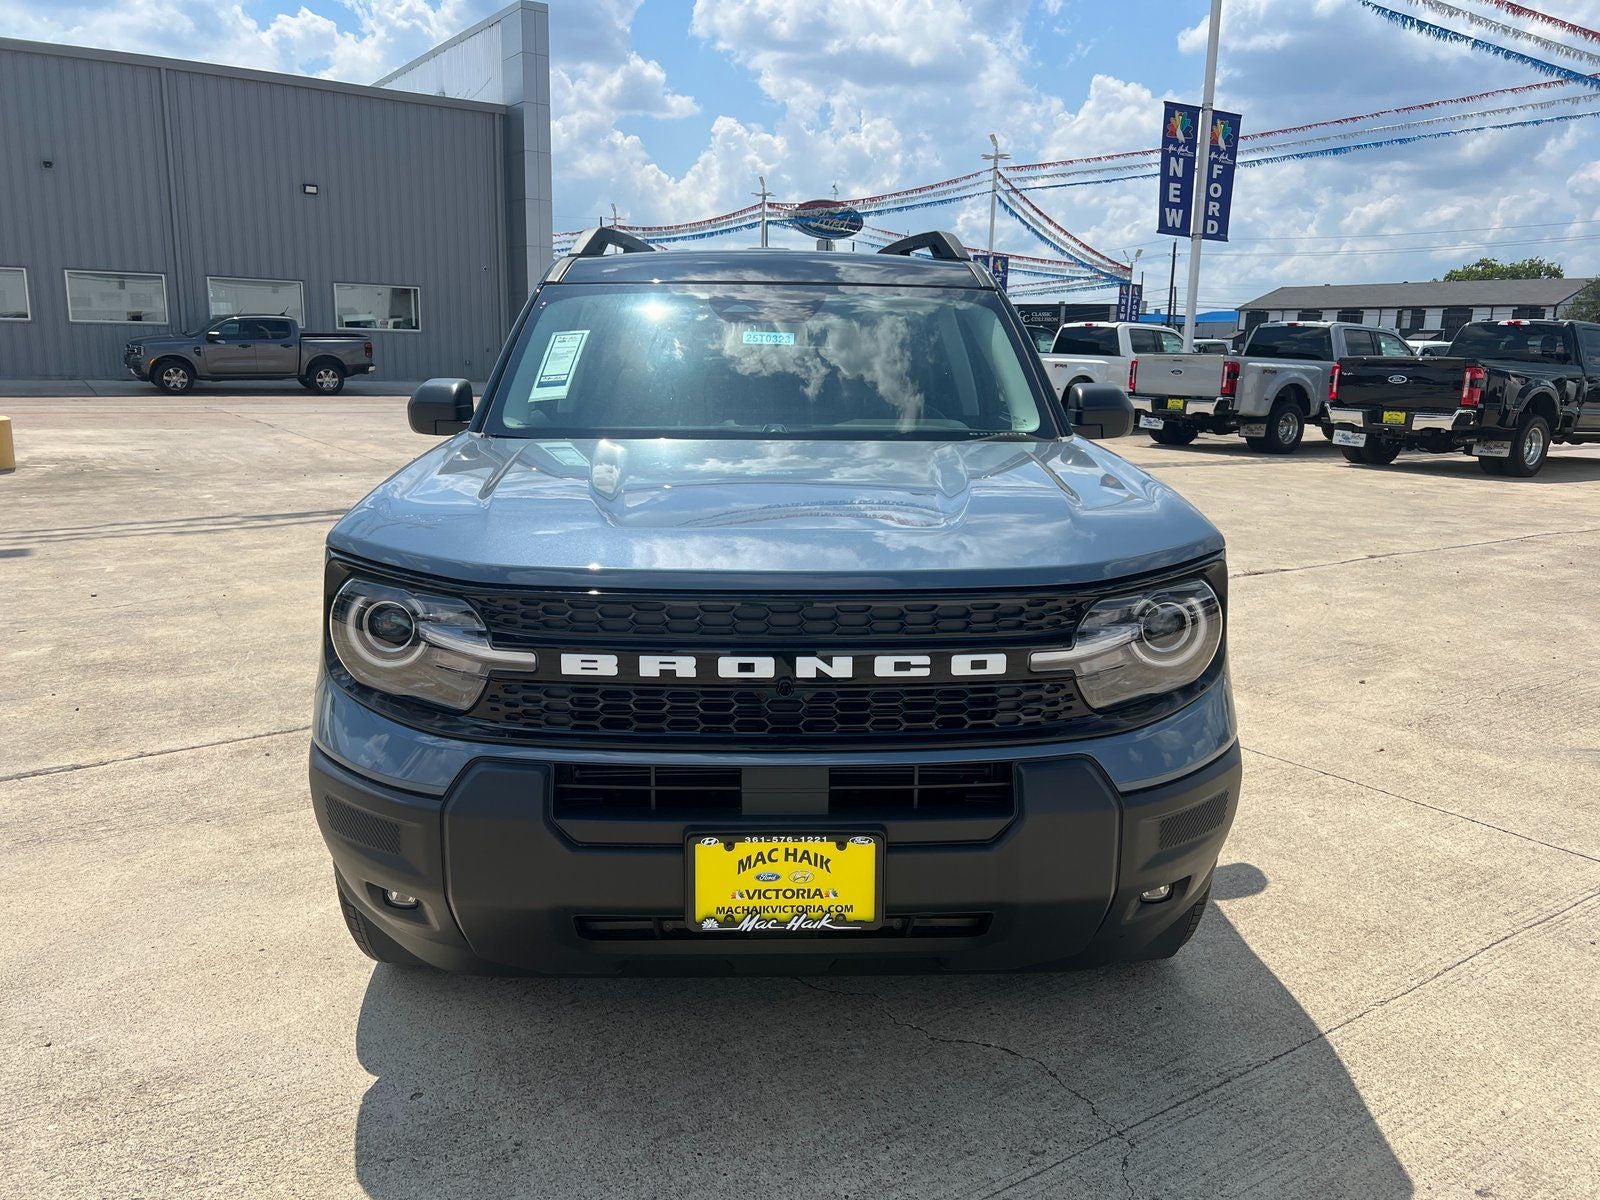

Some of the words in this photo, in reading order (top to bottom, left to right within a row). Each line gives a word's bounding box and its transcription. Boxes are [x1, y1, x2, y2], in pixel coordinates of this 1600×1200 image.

[1164, 156, 1184, 229] NEW
[1206, 163, 1224, 235] FORD
[1119, 298, 1127, 320] NEW
[746, 334, 791, 344] 25T0323
[560, 653, 1007, 678] BRONCO
[737, 847, 779, 875] MAC
[784, 847, 833, 874] HAIK
[759, 872, 778, 881] Ford
[745, 888, 825, 900] VICTORIA
[716, 904, 854, 915] MACHAIKVICTORIA.COM
[737, 913, 784, 932] Mac
[786, 913, 835, 930] Haik
